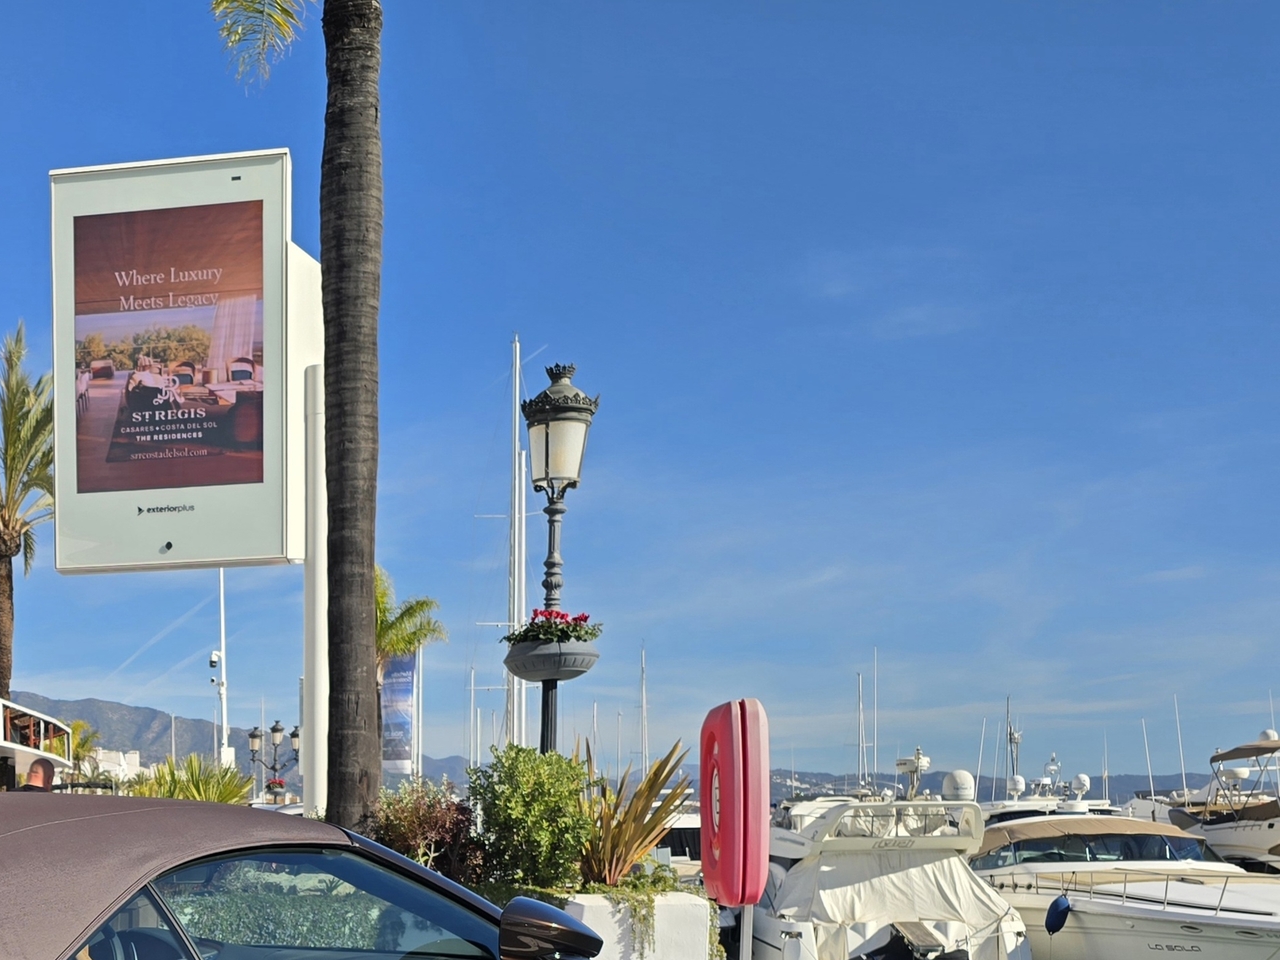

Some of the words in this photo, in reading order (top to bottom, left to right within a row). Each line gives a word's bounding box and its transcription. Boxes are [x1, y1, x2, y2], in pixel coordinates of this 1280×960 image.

[114, 269, 165, 287] Where
[170, 267, 223, 285] Luxury
[119, 295, 164, 311] Meets
[168, 292, 219, 310] Legacy
[155, 407, 206, 421] REGIS
[120, 425, 155, 434] CASARES
[160, 423, 185, 431] COSTA
[153, 431, 203, 441] RESIDENCES
[146, 504, 195, 513] exteriorplus
